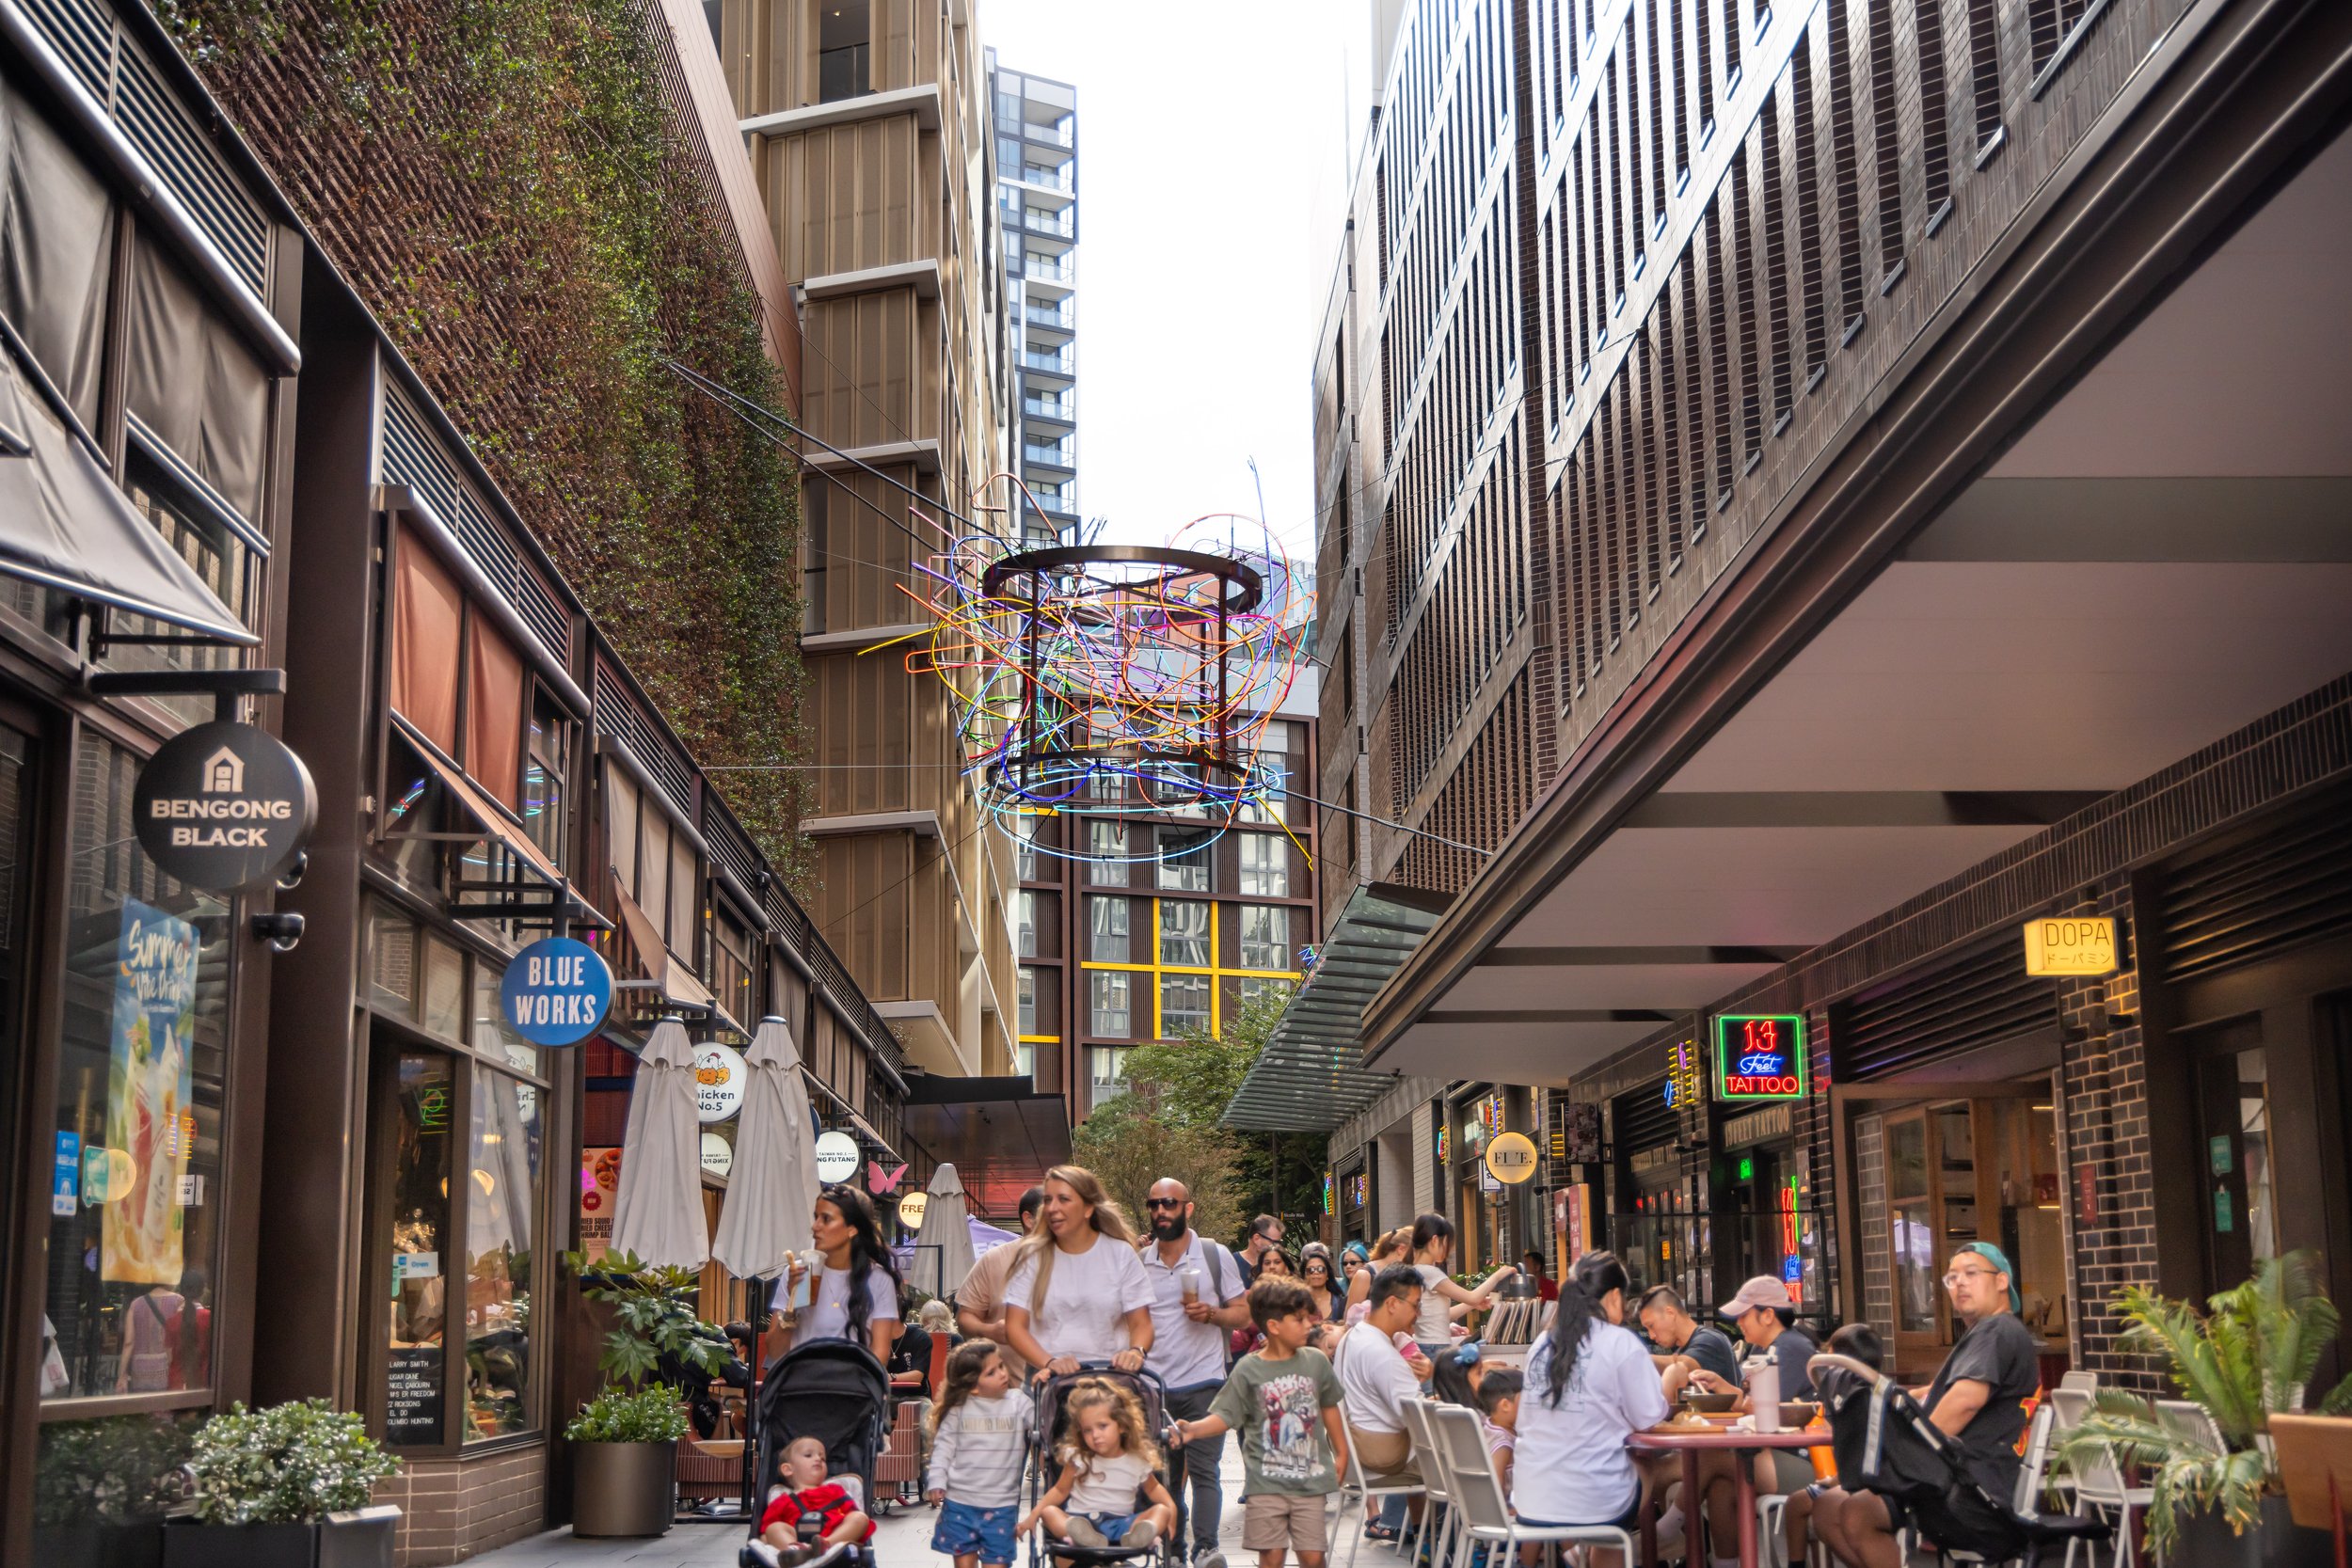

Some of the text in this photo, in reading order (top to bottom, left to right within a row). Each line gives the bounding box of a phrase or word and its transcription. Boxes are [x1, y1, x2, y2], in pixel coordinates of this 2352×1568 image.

[151, 800, 292, 819] BENGONG
[172, 827, 268, 847] BLACK
[2045, 923, 2110, 946] DOPA
[129, 918, 192, 979] Summer
[529, 957, 585, 986] BLUE
[516, 994, 596, 1025] WORKS
[1743, 1020, 1776, 1052] 13
[1740, 1053, 1782, 1074] Feet
[1725, 1076, 1798, 1093] TATTOO
[698, 1101, 723, 1111] No.5
[1754, 1105, 1789, 1138] TATTOO
[901, 1205, 924, 1213] FRE
